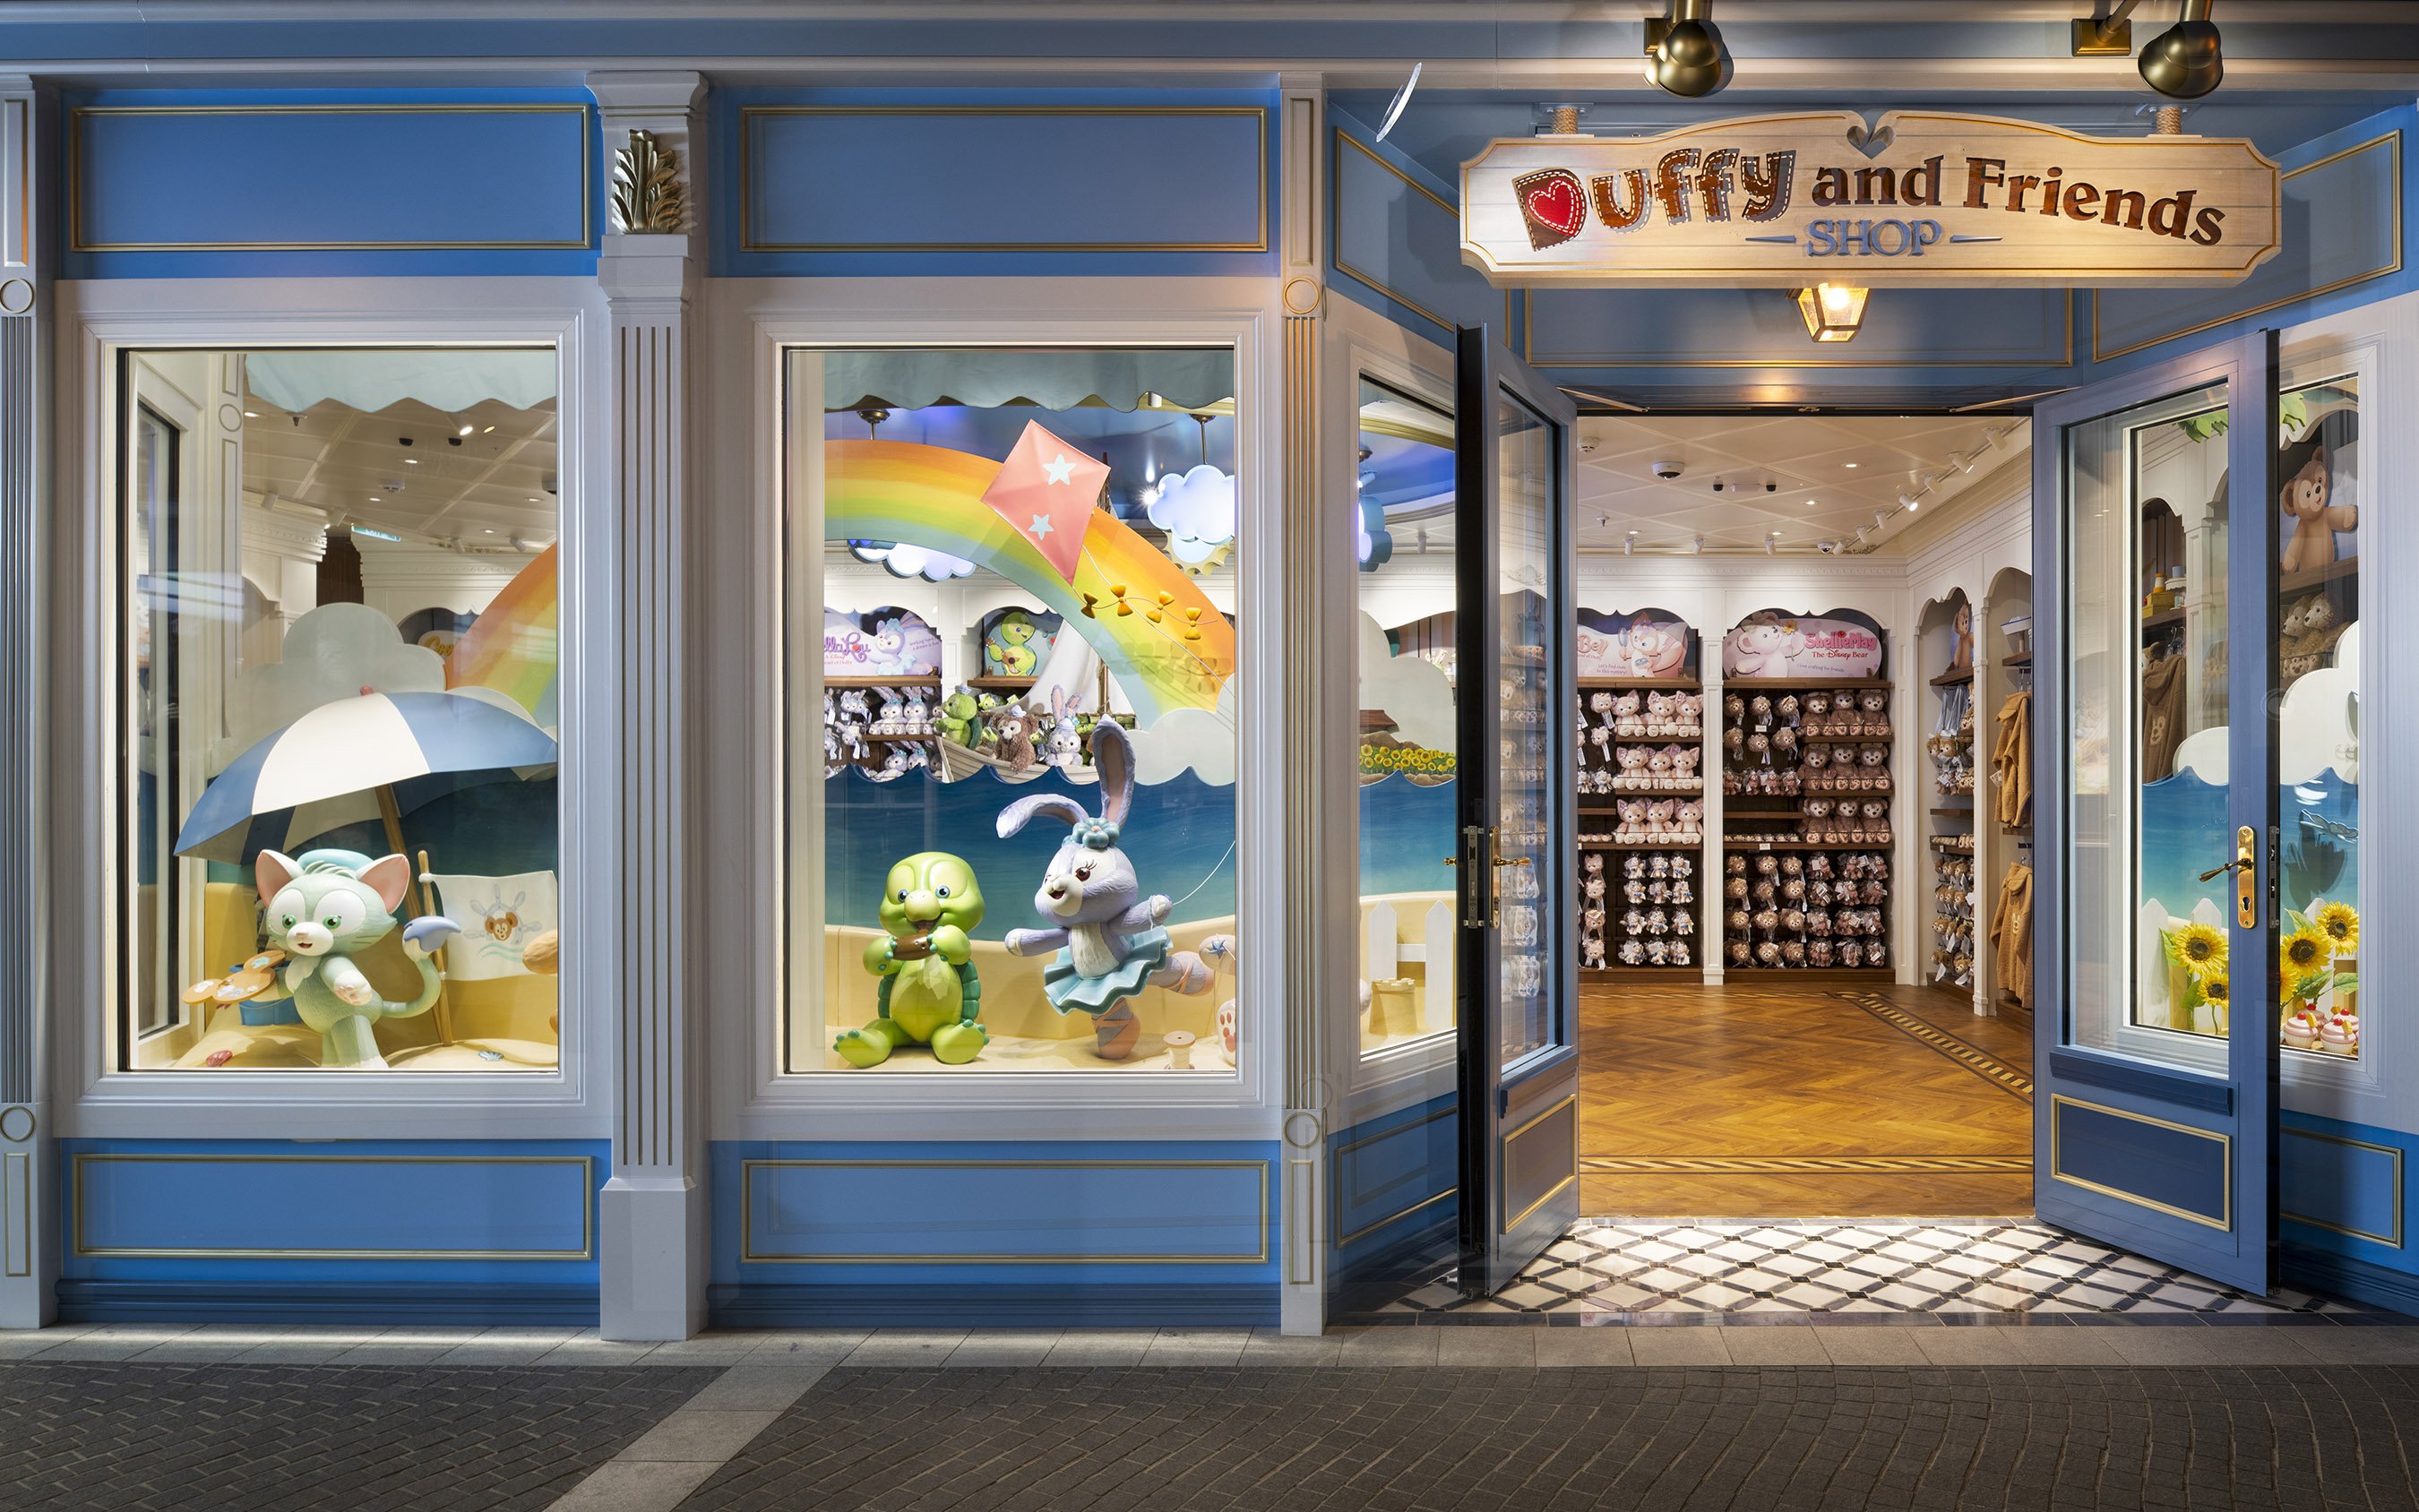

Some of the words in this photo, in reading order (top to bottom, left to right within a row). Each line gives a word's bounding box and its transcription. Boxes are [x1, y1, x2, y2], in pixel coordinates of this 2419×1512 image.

[1512, 148, 1796, 252] Duffy
[1812, 154, 1944, 207] and
[1963, 157, 2226, 246] Friends
[1807, 219, 1943, 257] SHOP
[1805, 631, 1877, 651] ShellieMay
[1826, 649, 1851, 660] Disney
